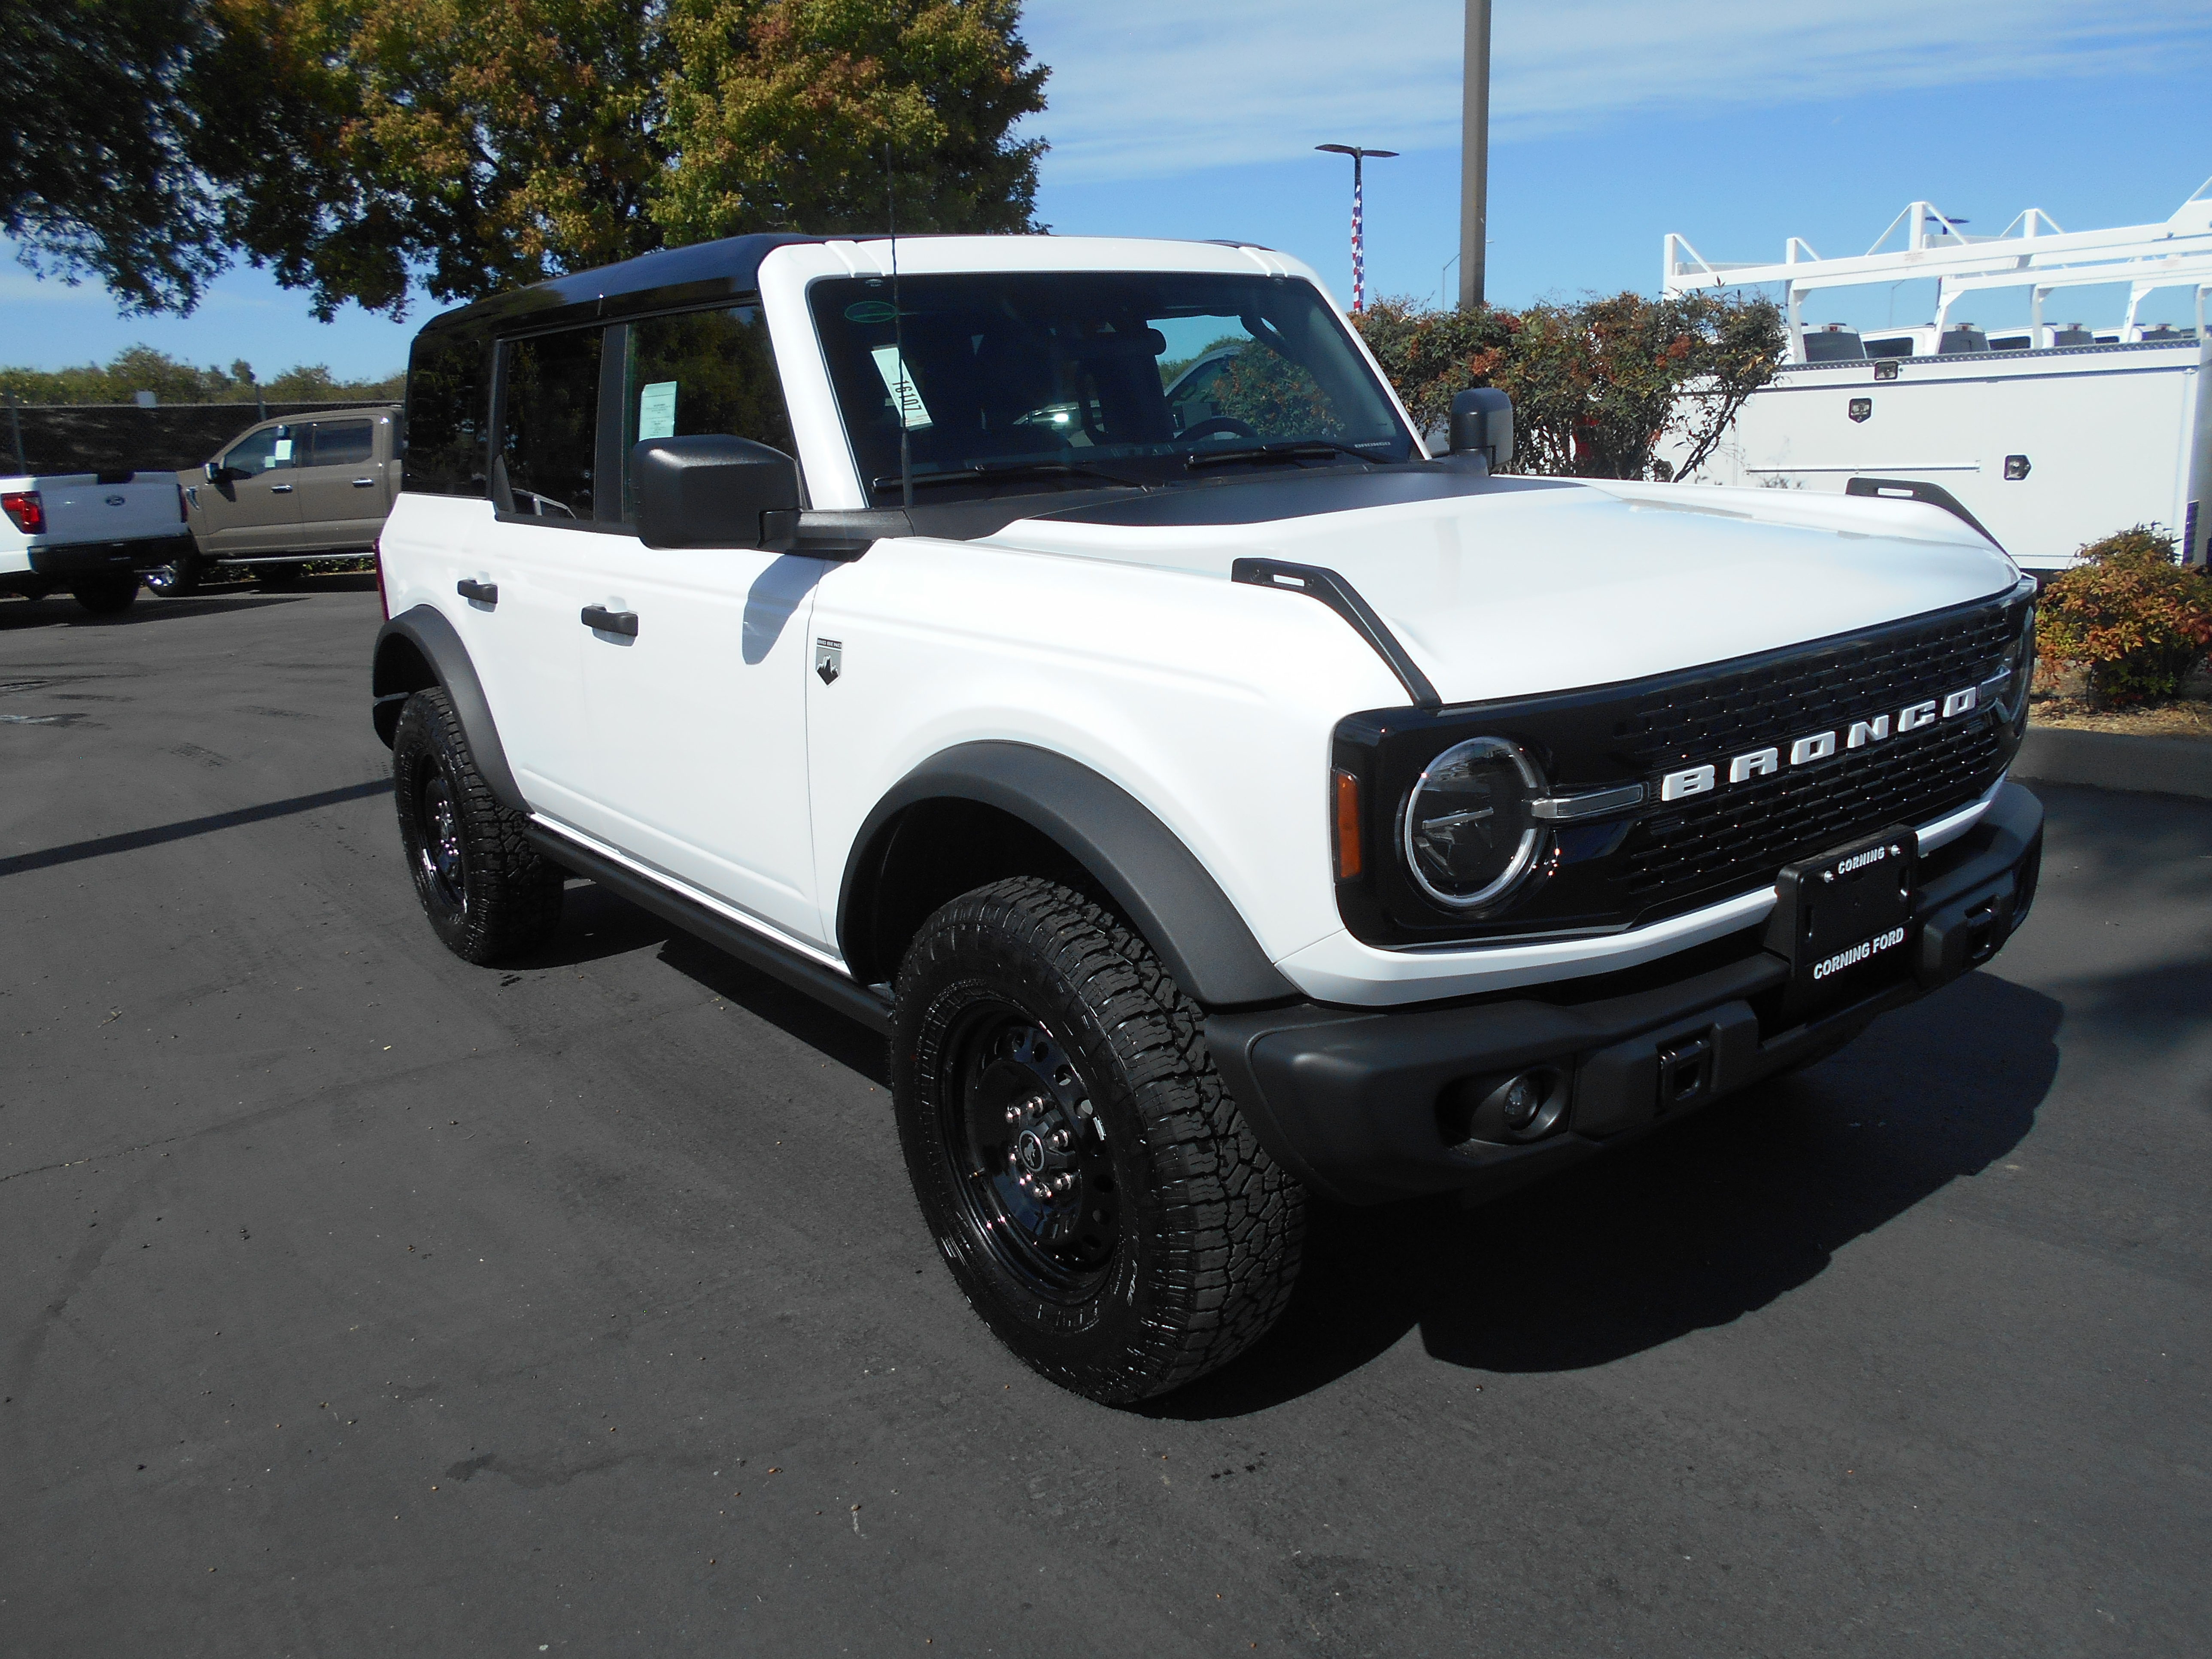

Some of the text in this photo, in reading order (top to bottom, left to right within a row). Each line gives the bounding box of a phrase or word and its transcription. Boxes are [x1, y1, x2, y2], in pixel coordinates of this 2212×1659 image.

[892, 380, 922, 410] 16107
[1661, 686, 1977, 802] BRONCO
[1838, 846, 1885, 875] CORNING
[1813, 927, 1904, 979] CORNING FORD
